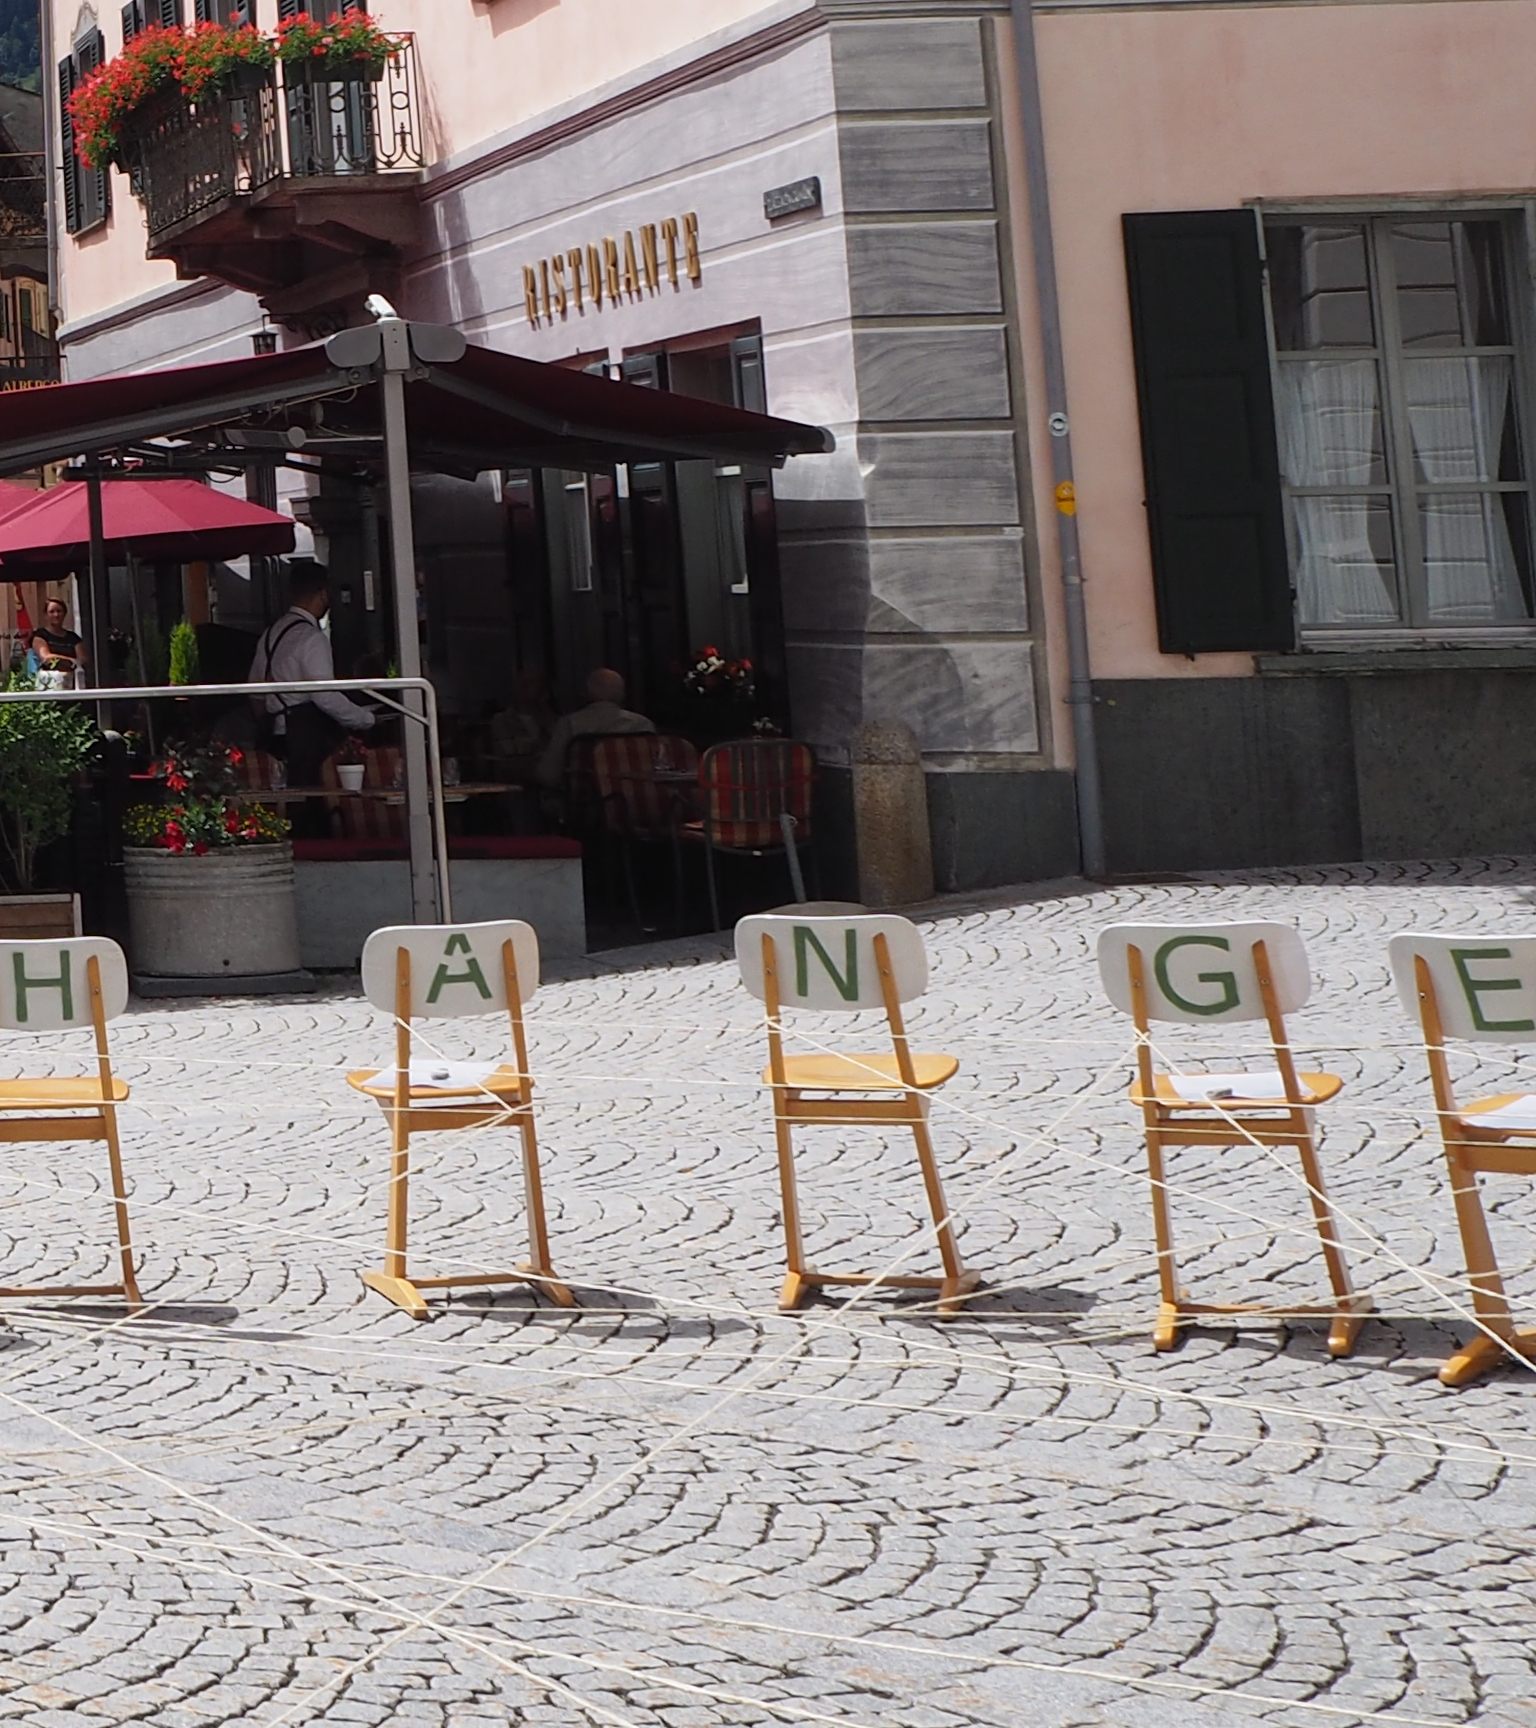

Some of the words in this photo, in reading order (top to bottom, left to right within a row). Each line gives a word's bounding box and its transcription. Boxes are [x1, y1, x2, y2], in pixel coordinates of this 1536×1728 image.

[522, 211, 702, 325] RISTORANTE
[12, 949, 74, 1023] H
[426, 933, 493, 1003] A
[793, 926, 859, 1002] N
[1154, 935, 1240, 1016] G
[1450, 947, 1536, 1032] E
